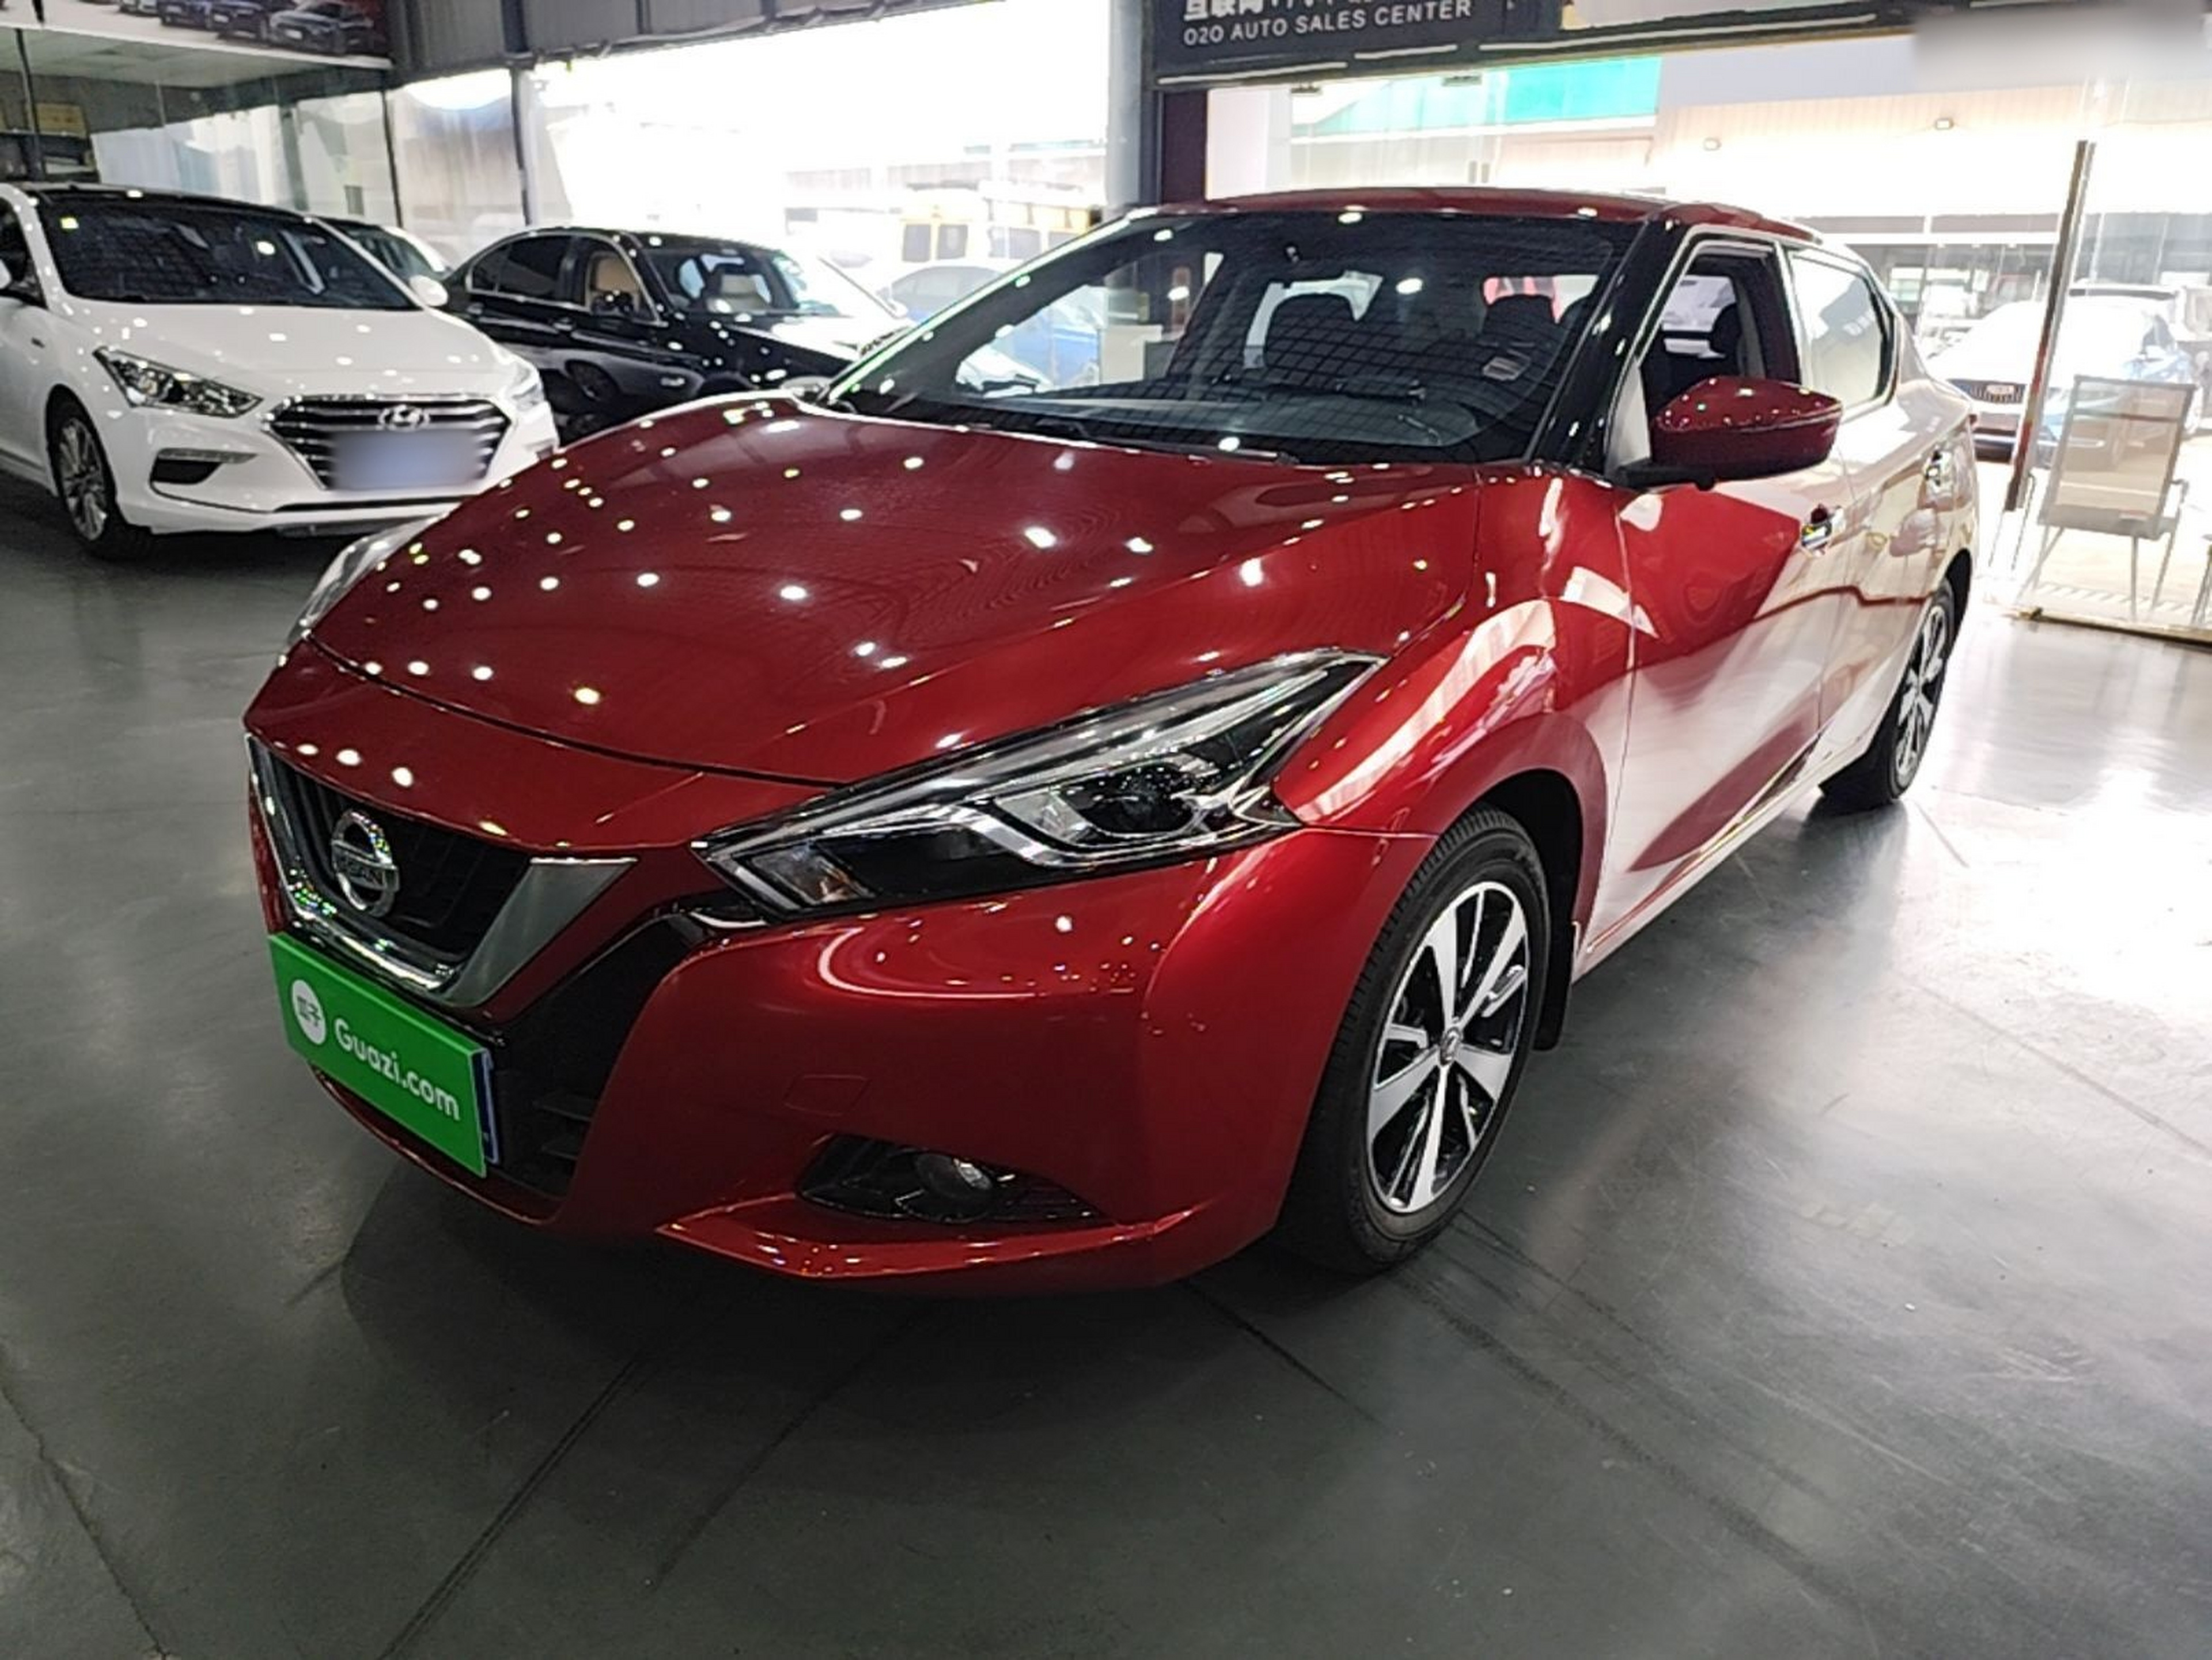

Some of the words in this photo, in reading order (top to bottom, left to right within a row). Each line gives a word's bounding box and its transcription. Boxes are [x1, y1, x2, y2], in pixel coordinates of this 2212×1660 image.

[1230, 18, 1287, 40] AUTO
[1295, 9, 1366, 33] SALES
[1374, 0, 1472, 26] CENTER
[334, 1018, 460, 1121] Guazi.com
